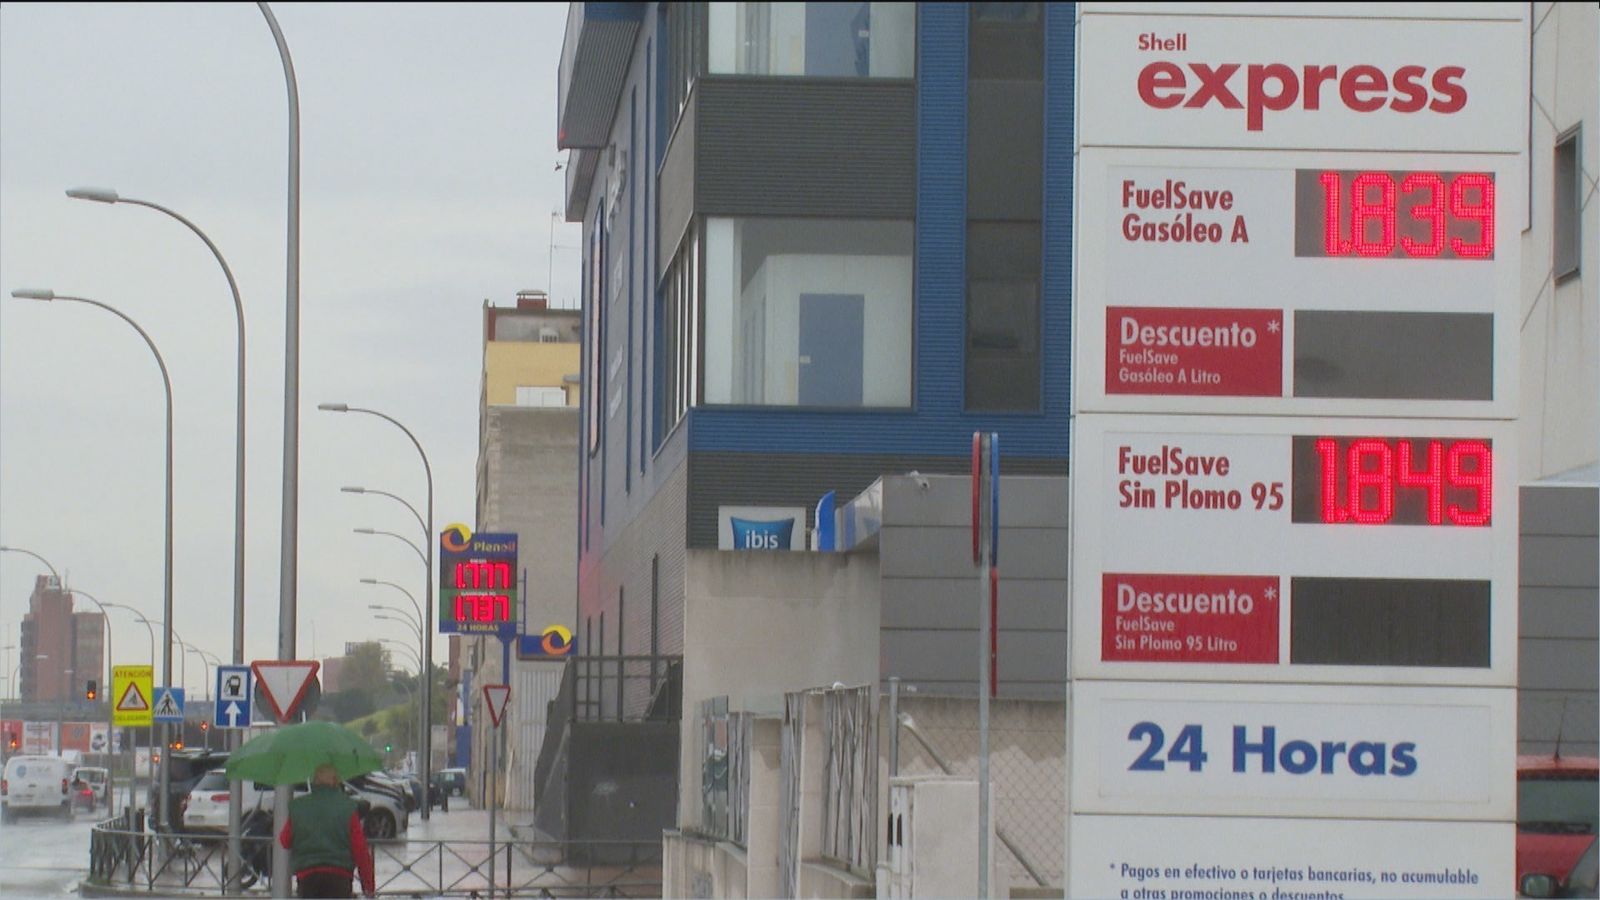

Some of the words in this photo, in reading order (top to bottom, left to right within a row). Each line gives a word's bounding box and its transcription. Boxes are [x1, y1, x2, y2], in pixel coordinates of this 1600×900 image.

[1139, 33, 1186, 51] Shell
[1138, 62, 1467, 131] express
[1123, 180, 1233, 211] FuelSave
[1123, 213, 1222, 242] Gasóleo
[1231, 215, 1249, 243] A
[1320, 171, 1495, 257] 1.839
[1121, 317, 1256, 348] Descuento
[1120, 349, 1178, 364] FuelSave
[1119, 367, 1173, 384] Gasóleo
[1178, 368, 1186, 383] A
[1191, 369, 1220, 384] Litro
[1119, 445, 1229, 476] FuelSave
[1119, 480, 1155, 508] Sin
[1165, 479, 1241, 509] Plomo
[1251, 482, 1283, 510] 95
[1316, 438, 1492, 524] 1.849
[474, 541, 515, 553] Plenoil
[745, 530, 779, 549] ibis
[1117, 584, 1253, 614] Descuento
[1116, 616, 1174, 631] FuelSave
[1116, 635, 1135, 649] Sin
[1140, 635, 1182, 650] Plomo
[1187, 636, 1202, 650] 95
[1208, 636, 1237, 651] Litro
[1128, 722, 1207, 772] 24
[1233, 725, 1417, 776] Horas
[1122, 863, 1159, 881] Pagos
[1165, 868, 1180, 878] en
[1185, 864, 1236, 879] efectivo
[1241, 870, 1248, 879] o
[1253, 867, 1303, 883] tarjetas
[1308, 866, 1376, 884] bancarias,
[1381, 872, 1397, 882] no
[1402, 868, 1478, 884] acumulable
[1121, 890, 1128, 899] a
[1134, 887, 1165, 900] otras
[1171, 888, 1254, 900] promociones
[1259, 892, 1267, 900] o
[1272, 887, 1344, 900] descuentos
